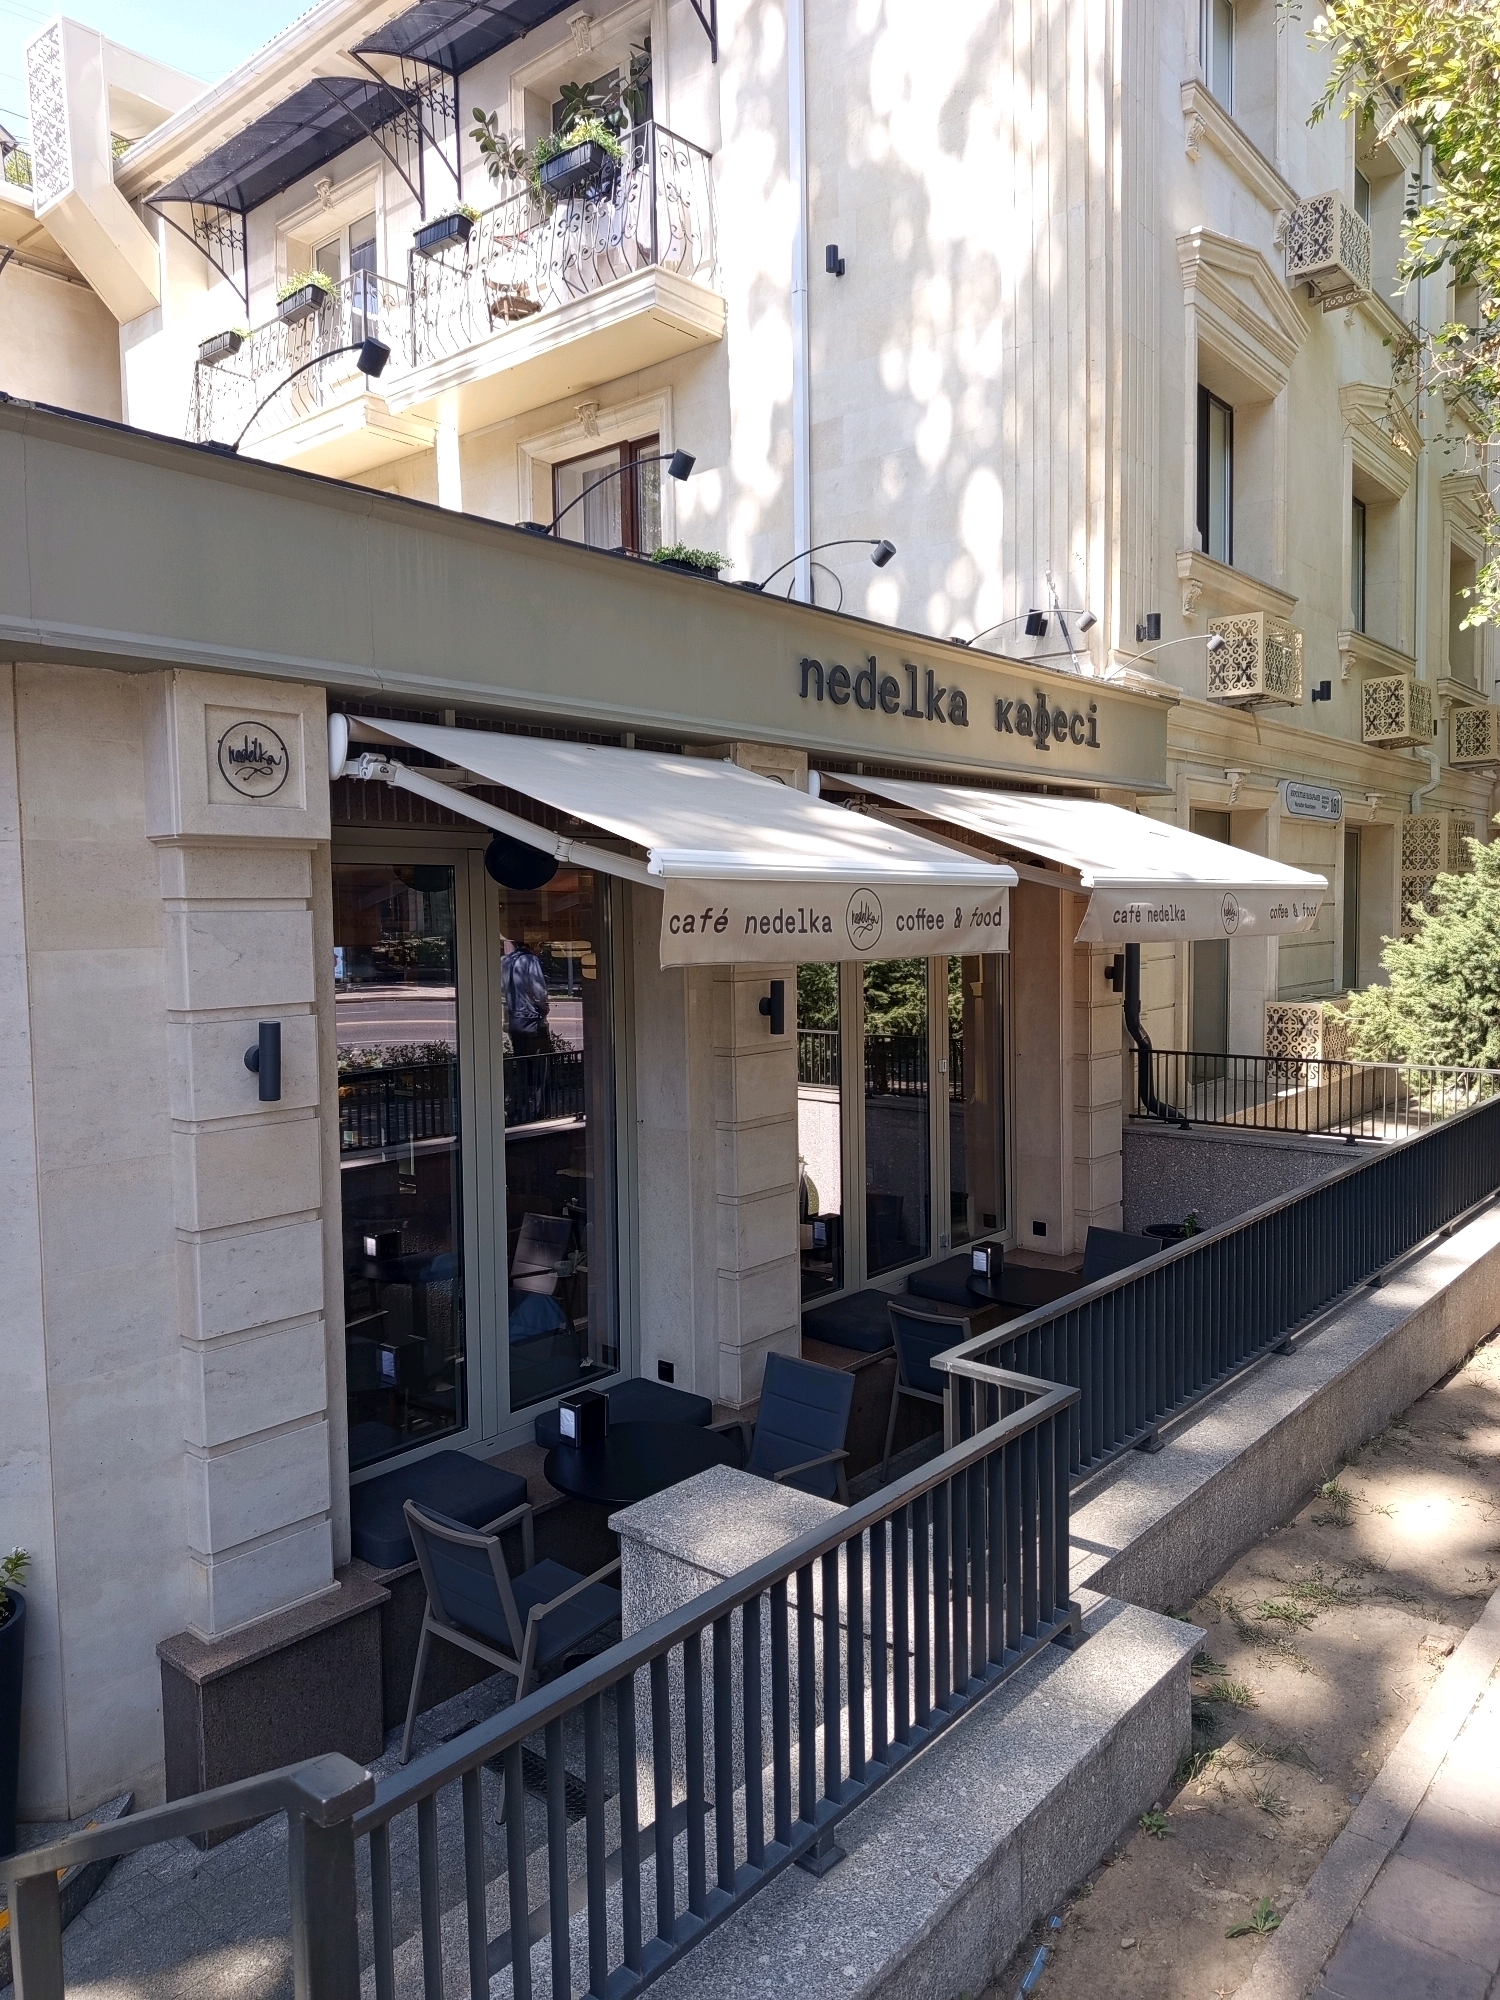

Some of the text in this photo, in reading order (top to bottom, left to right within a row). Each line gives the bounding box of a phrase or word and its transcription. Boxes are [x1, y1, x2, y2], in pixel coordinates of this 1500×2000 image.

[799, 655, 970, 727] nedelka
[669, 907, 833, 935] café nedelka
[895, 905, 1002, 932] coffee & food
[1112, 904, 1187, 924] café nedelka
